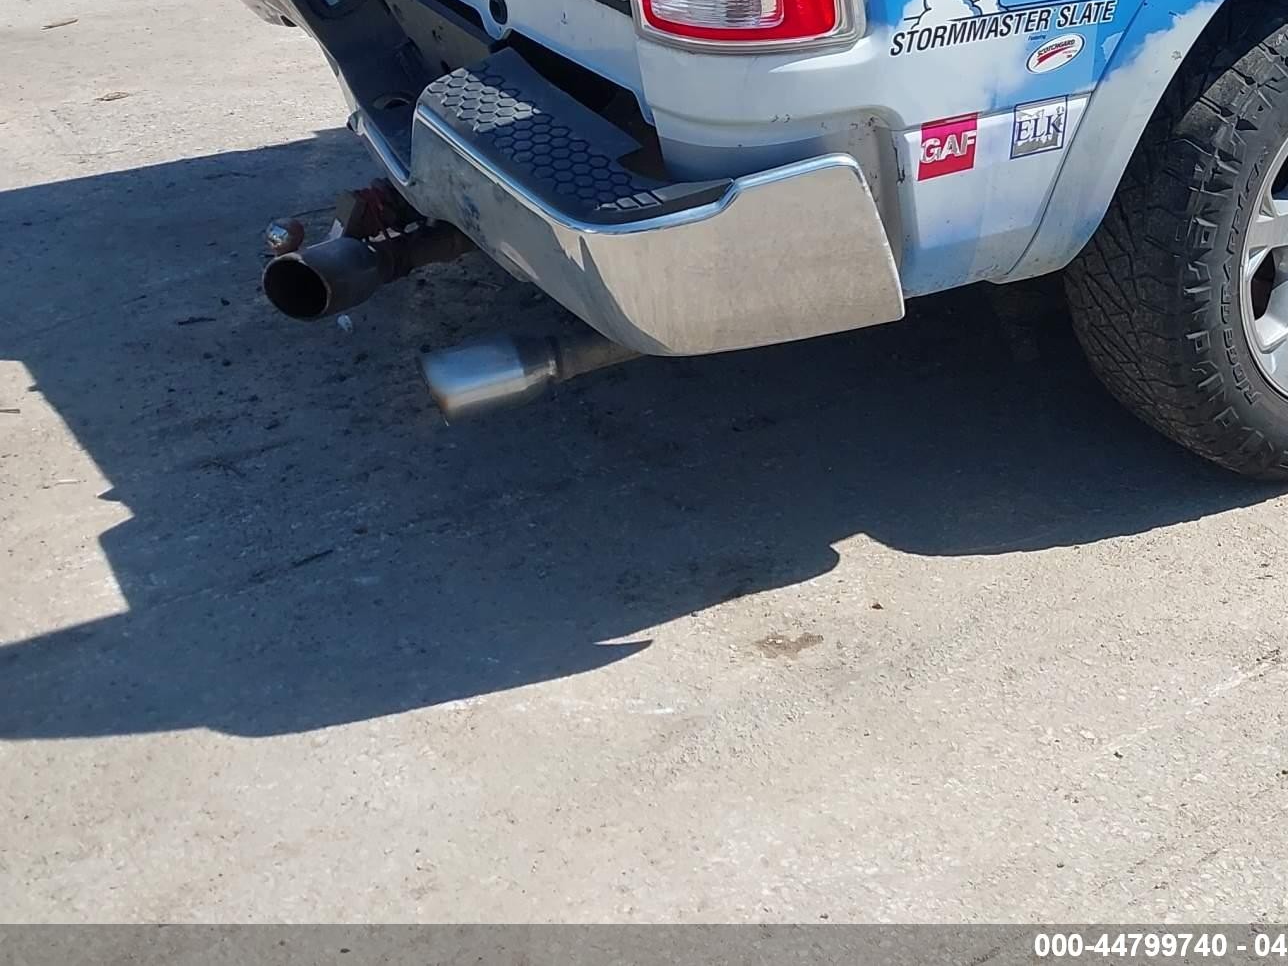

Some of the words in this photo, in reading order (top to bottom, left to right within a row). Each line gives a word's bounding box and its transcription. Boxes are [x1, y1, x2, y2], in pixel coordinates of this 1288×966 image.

[890, 9, 1050, 56] STORMMASTER
[1056, 0, 1118, 29] SLATE
[1016, 114, 1064, 142] ELK
[920, 131, 977, 163] GAF
